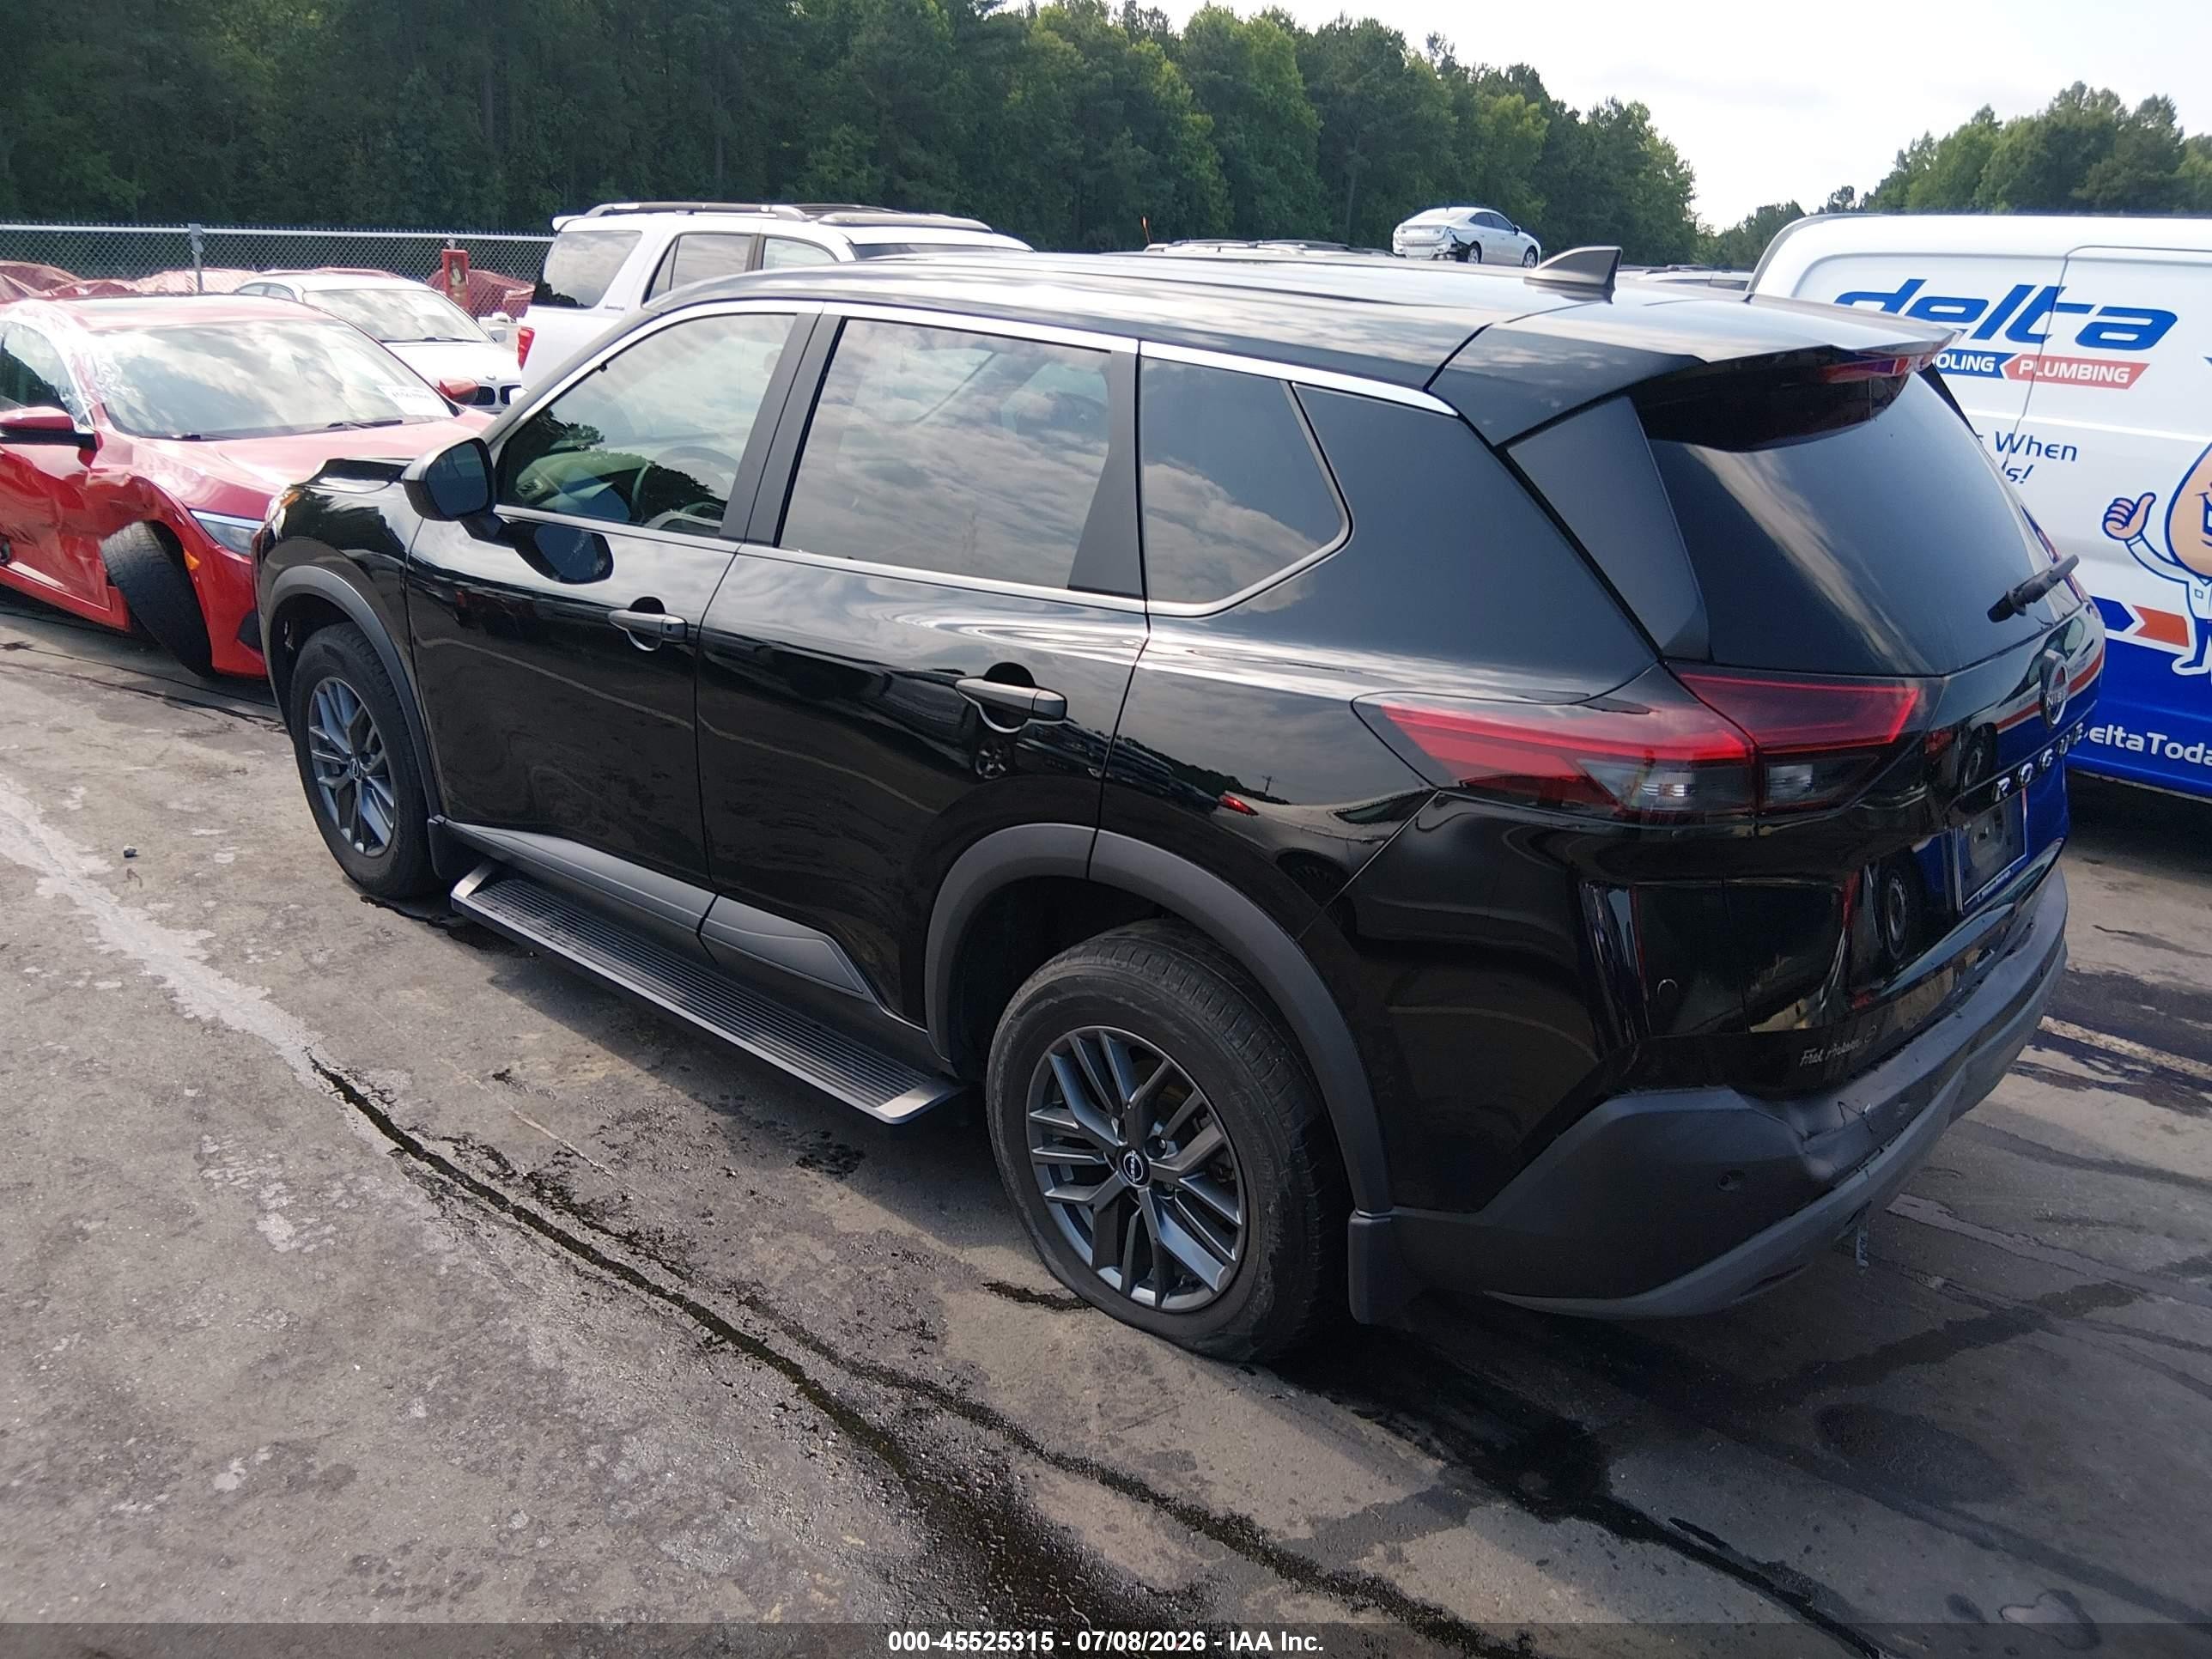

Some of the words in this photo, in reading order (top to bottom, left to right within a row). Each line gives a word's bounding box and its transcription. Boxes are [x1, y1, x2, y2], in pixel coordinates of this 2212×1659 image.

[1833, 278, 2179, 350] delta
[1931, 352, 1996, 373] OLING
[2018, 362, 2130, 384] PLUMBING
[1995, 430, 2078, 462] When
[2087, 724, 2212, 767] eltaToda
